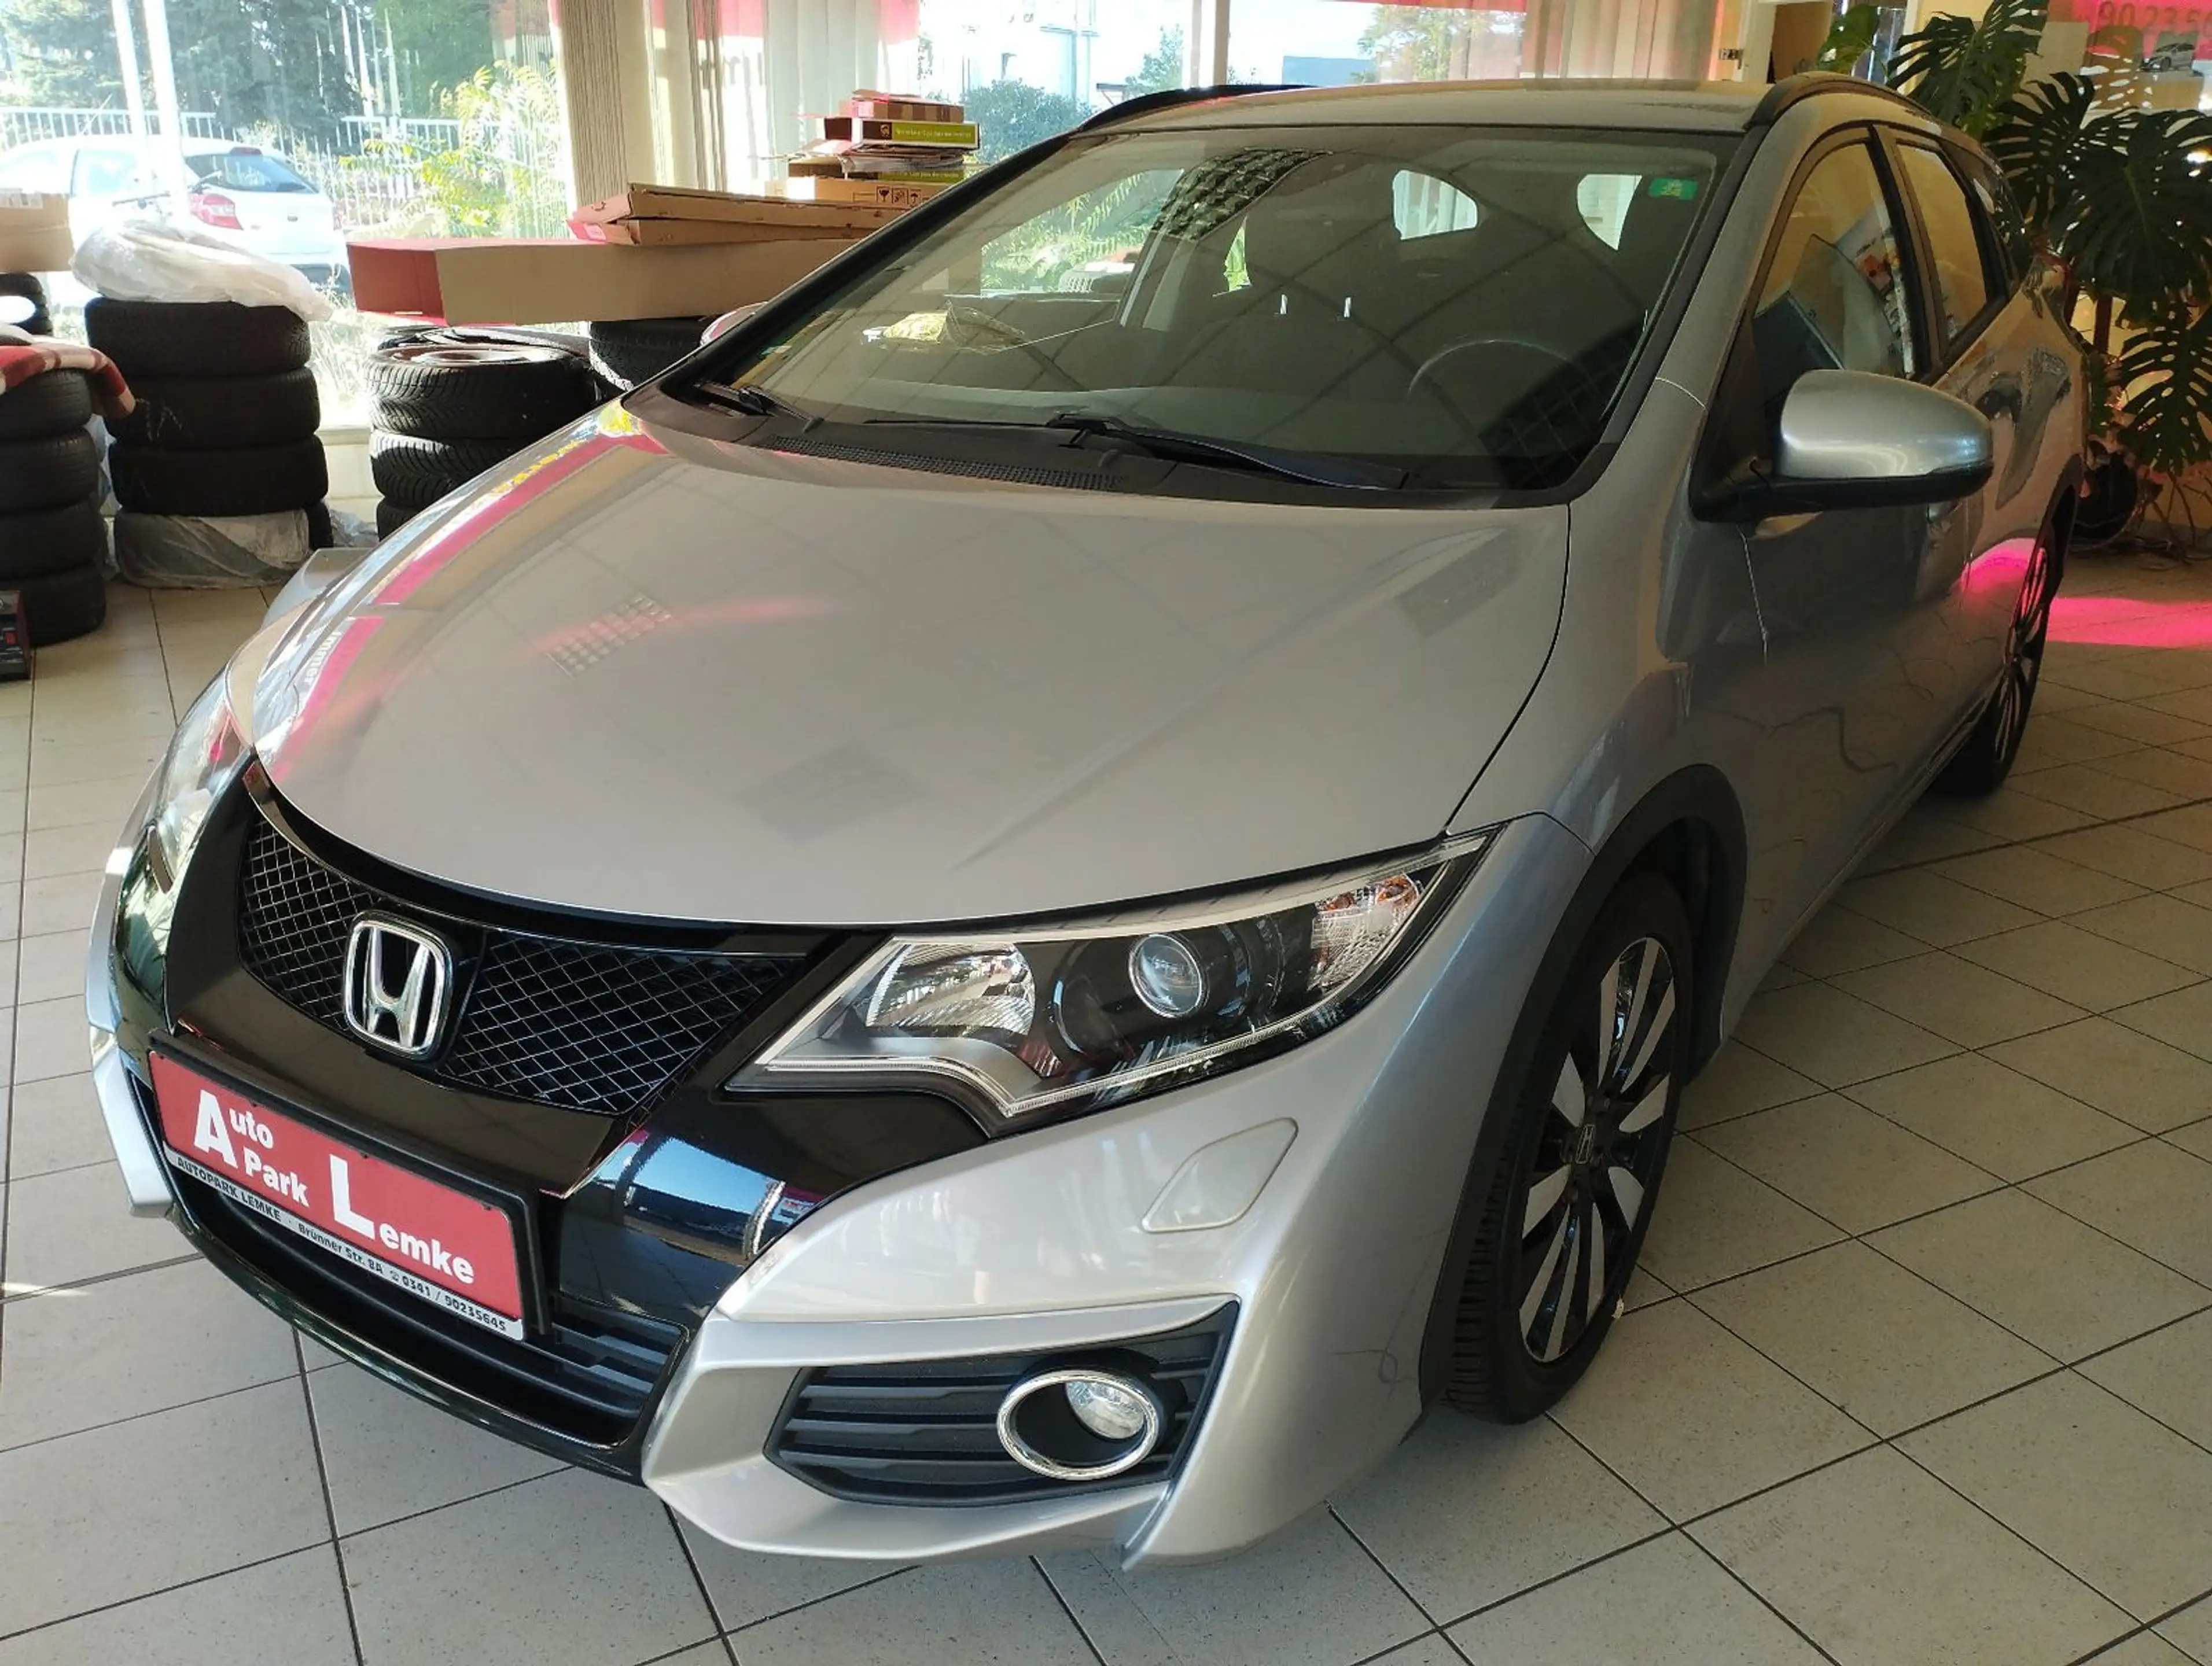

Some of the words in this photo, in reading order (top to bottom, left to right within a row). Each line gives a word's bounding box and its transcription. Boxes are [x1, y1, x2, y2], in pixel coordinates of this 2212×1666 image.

[194, 1089, 274, 1169] Auto
[243, 1146, 310, 1208] Park
[178, 1157, 238, 1198] AUTOPARK
[241, 1192, 282, 1222] LEMKE
[346, 1247, 366, 1267] Str.
[368, 1258, 384, 1274] 8A
[402, 1276, 430, 1296] 0341
[444, 1294, 507, 1332] 90235645
[329, 1153, 475, 1284] Lemke
